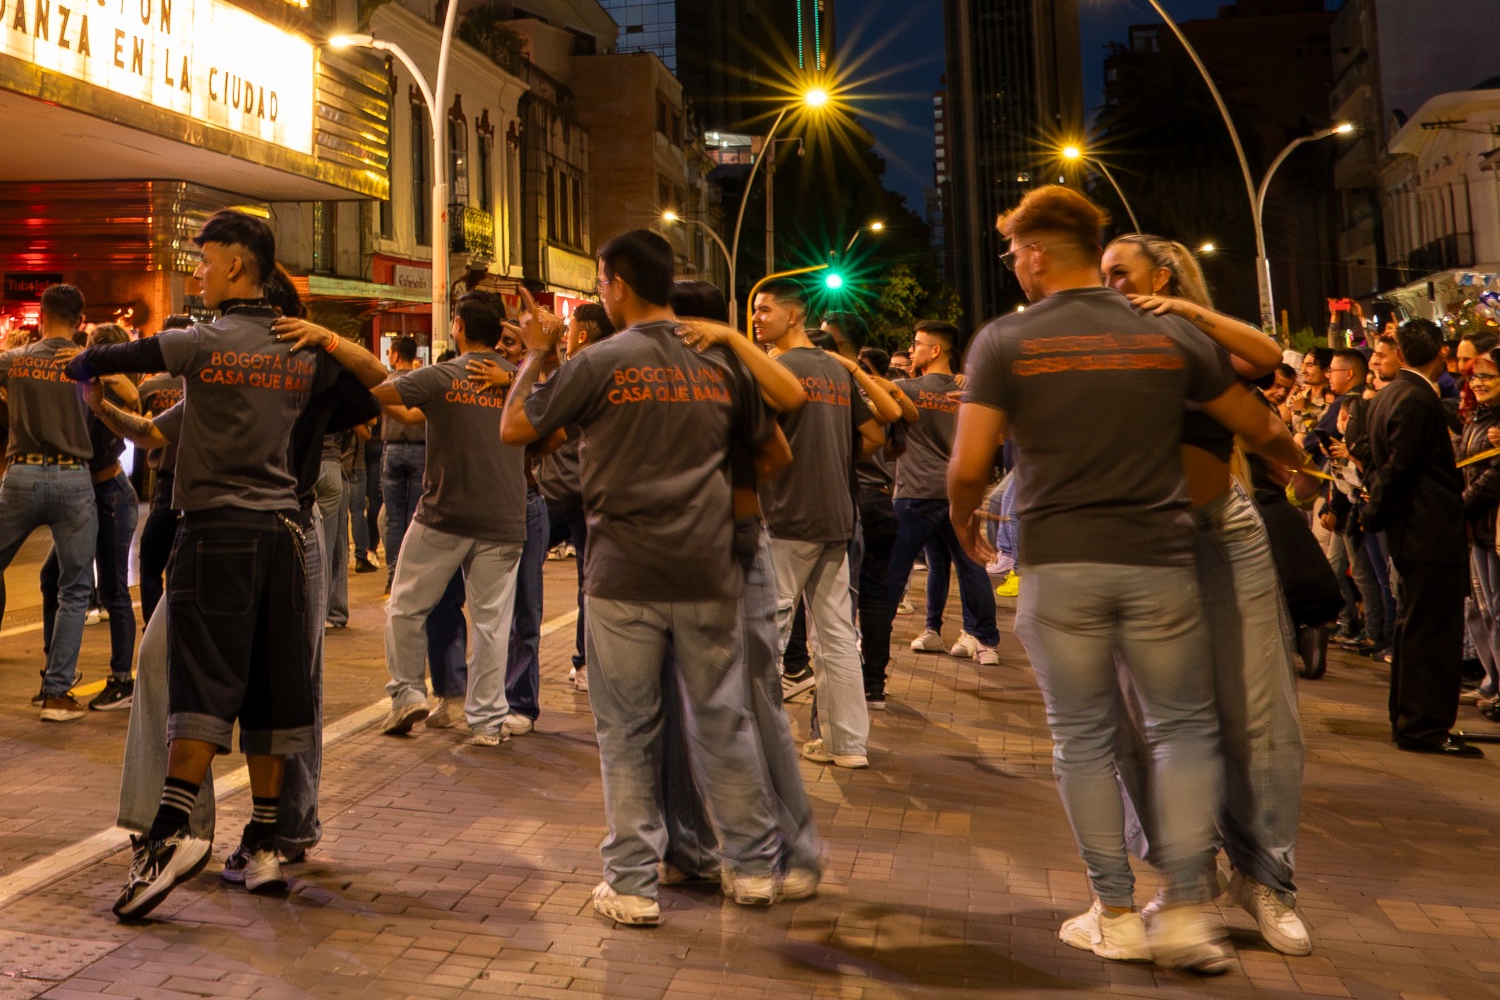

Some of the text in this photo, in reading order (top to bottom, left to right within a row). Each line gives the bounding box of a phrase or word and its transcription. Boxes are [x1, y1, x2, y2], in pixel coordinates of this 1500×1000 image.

[114, 27, 144, 76] EN
[165, 54, 191, 93] LA
[208, 66, 279, 123] CIUDAD
[211, 351, 282, 371] BOGOTÁ
[32, 368, 58, 382] QUE
[200, 368, 245, 386] CASA
[249, 372, 281, 390] QUE
[445, 390, 503, 409] CASA QUE
[608, 386, 654, 405] CASA
[656, 386, 691, 403] QUE
